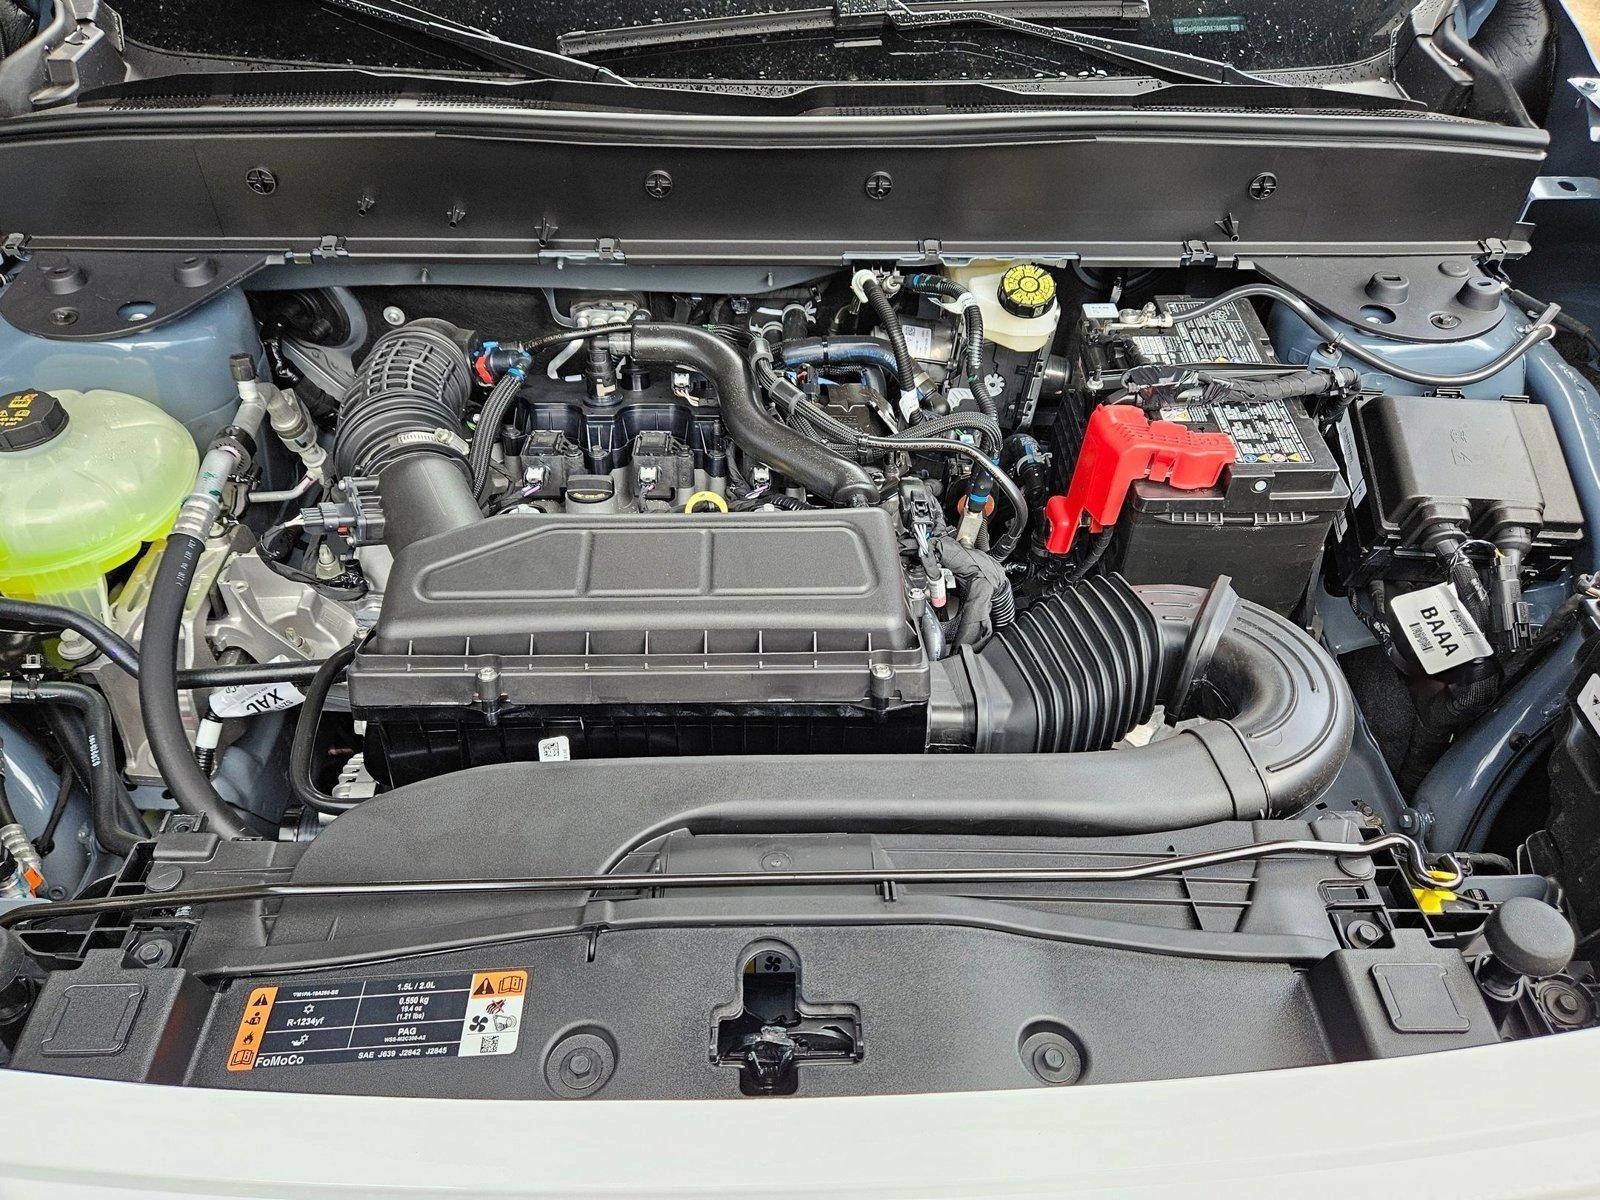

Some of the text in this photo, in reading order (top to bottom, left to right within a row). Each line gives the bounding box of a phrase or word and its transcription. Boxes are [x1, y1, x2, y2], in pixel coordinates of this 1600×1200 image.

[1420, 606, 1459, 657] BAAA
[419, 981, 435, 989] 2.0L
[398, 995, 430, 1005] 0.550 kg
[412, 1012, 425, 1020] lbs)
[286, 1016, 325, 1027] R-1234yf
[397, 1027, 417, 1036] PAG
[358, 1046, 448, 1059] SAE J639 J2842 J2845
[254, 1055, 304, 1067] FoMoCo
